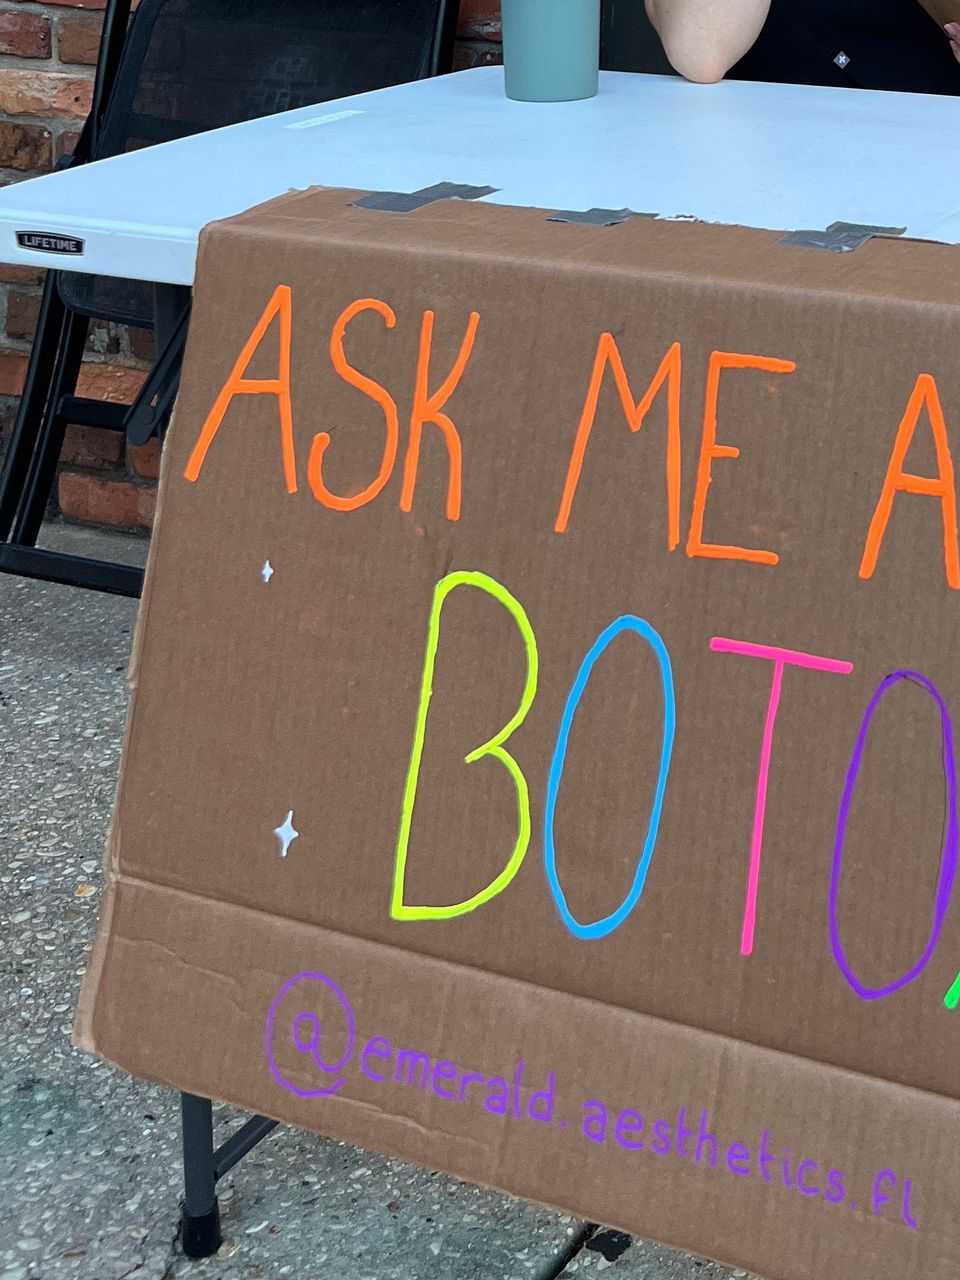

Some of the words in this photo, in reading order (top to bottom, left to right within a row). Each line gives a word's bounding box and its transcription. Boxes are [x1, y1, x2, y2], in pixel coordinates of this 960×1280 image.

[24, 235, 77, 251] LIFETIME
[184, 285, 480, 522] ASK
[555, 332, 796, 566] ME
[266, 971, 918, 1229] @emerald.aesthetics.fl
